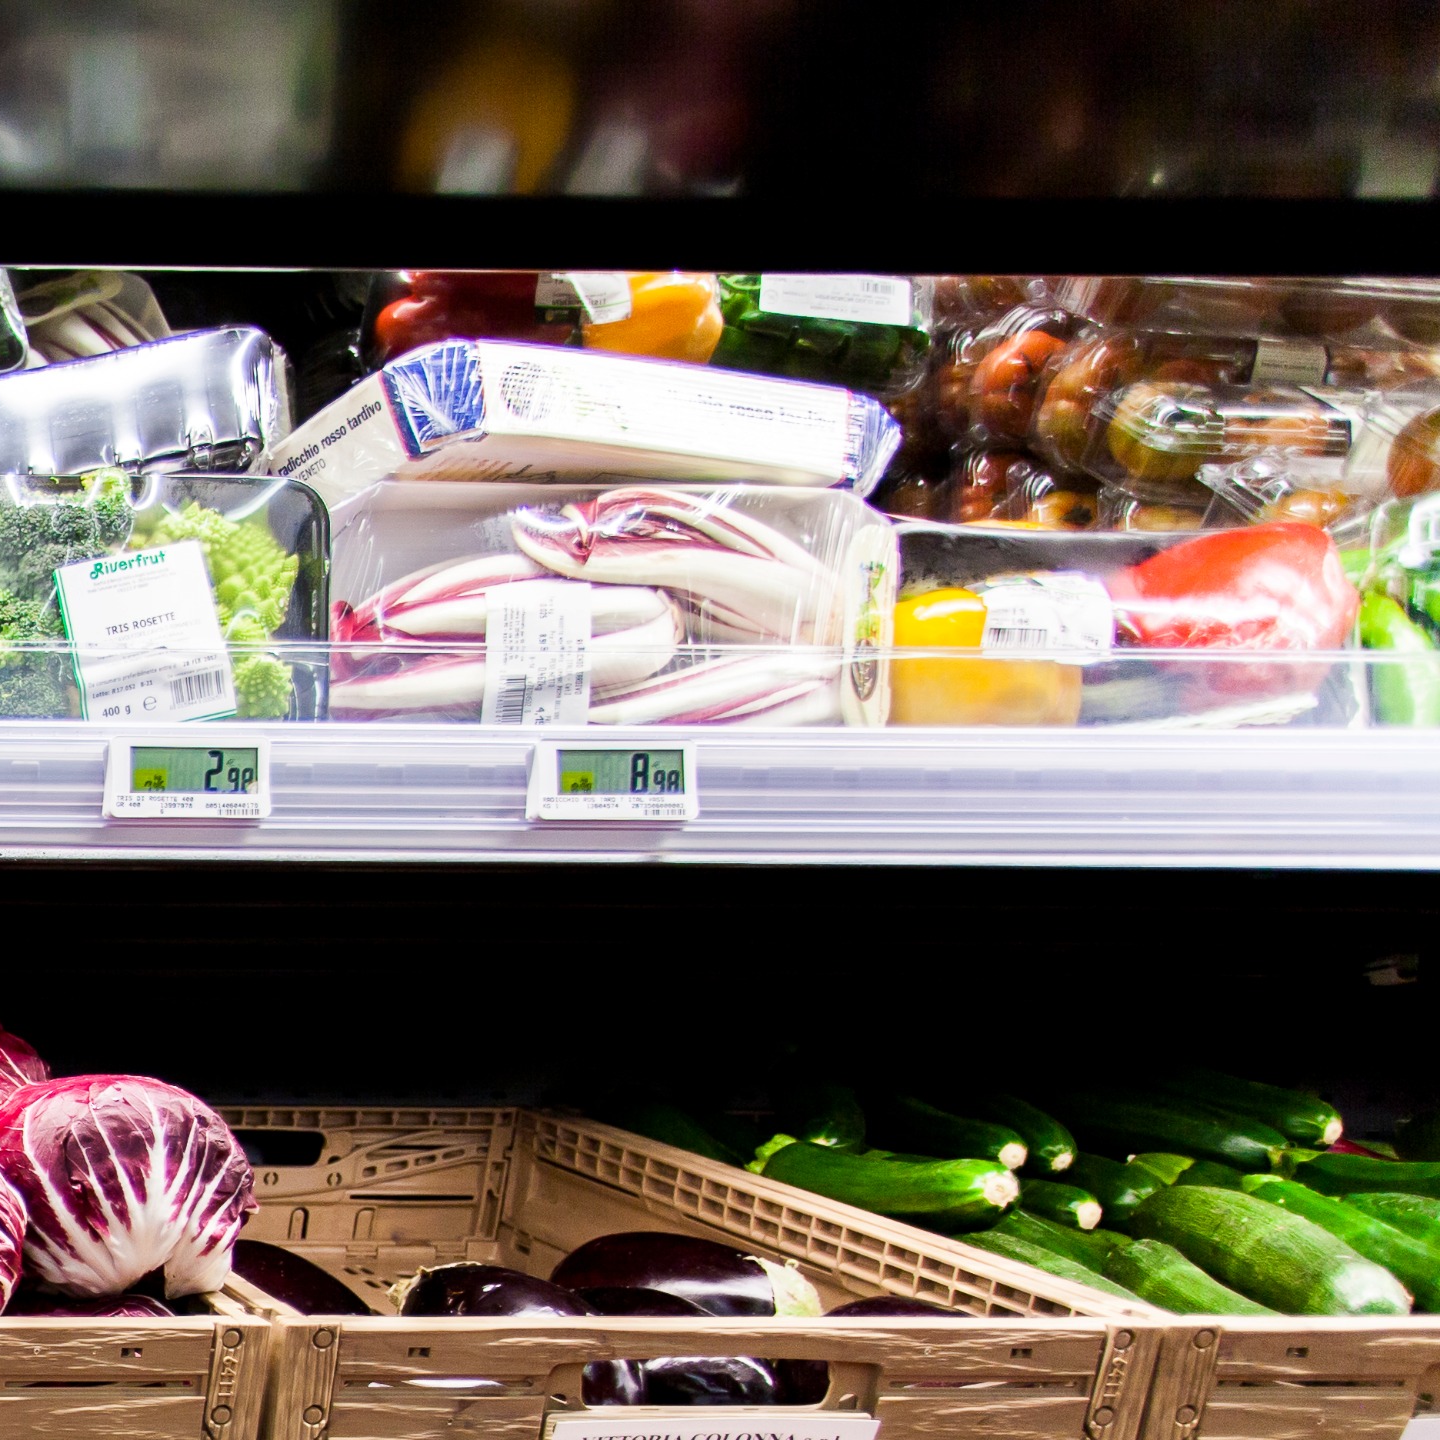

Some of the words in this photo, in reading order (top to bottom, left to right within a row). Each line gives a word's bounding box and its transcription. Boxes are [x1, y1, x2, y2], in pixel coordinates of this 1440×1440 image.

[278, 444, 320, 477] radicchio
[320, 424, 347, 450] rosso
[346, 400, 382, 430] tardivo
[90, 550, 166, 580] Riverfrut
[106, 620, 130, 636] TRIS
[132, 612, 176, 630] ROSETTE
[102, 704, 120, 718] 400
[124, 704, 132, 716] g
